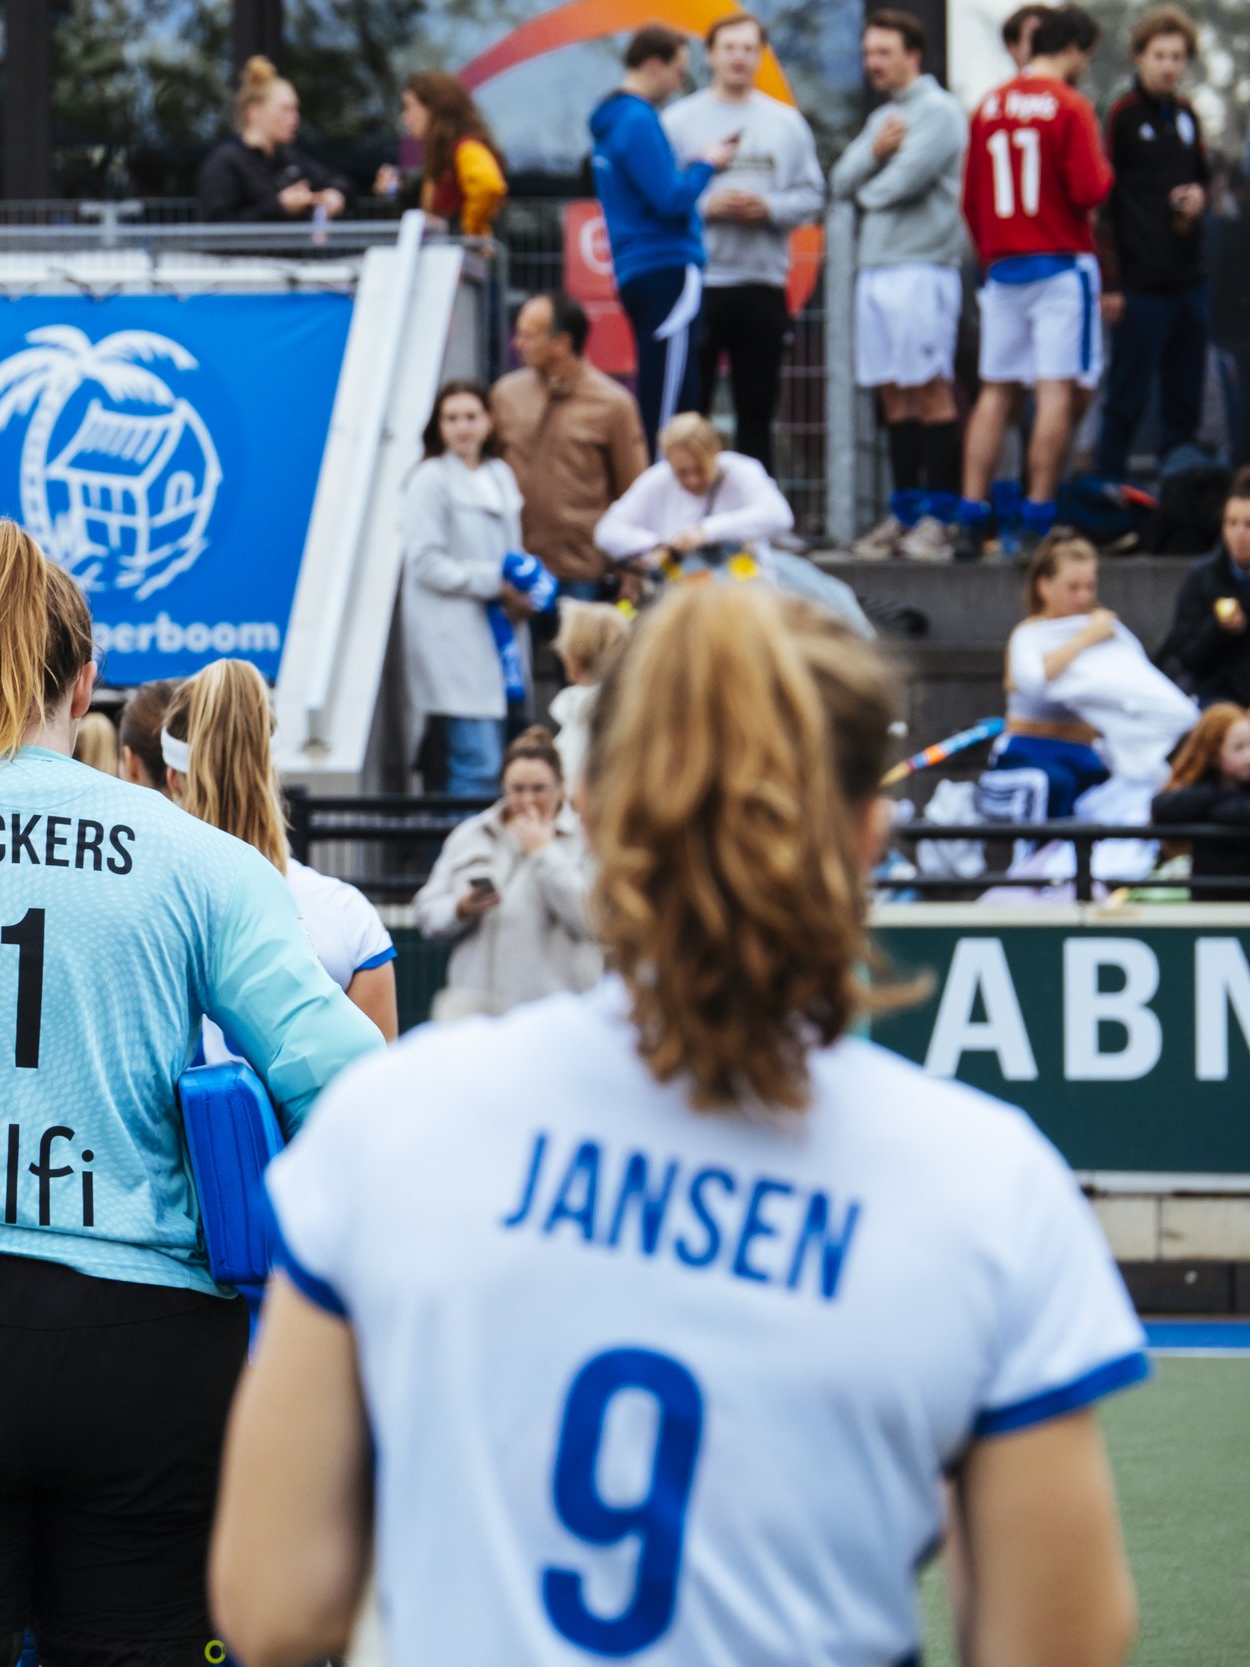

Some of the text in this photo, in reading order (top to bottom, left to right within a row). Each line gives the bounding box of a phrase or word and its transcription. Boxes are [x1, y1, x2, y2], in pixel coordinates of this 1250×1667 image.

[0, 907, 45, 1069] 1
[501, 1131, 861, 1300] JANSEN
[542, 1344, 705, 1659] 9
